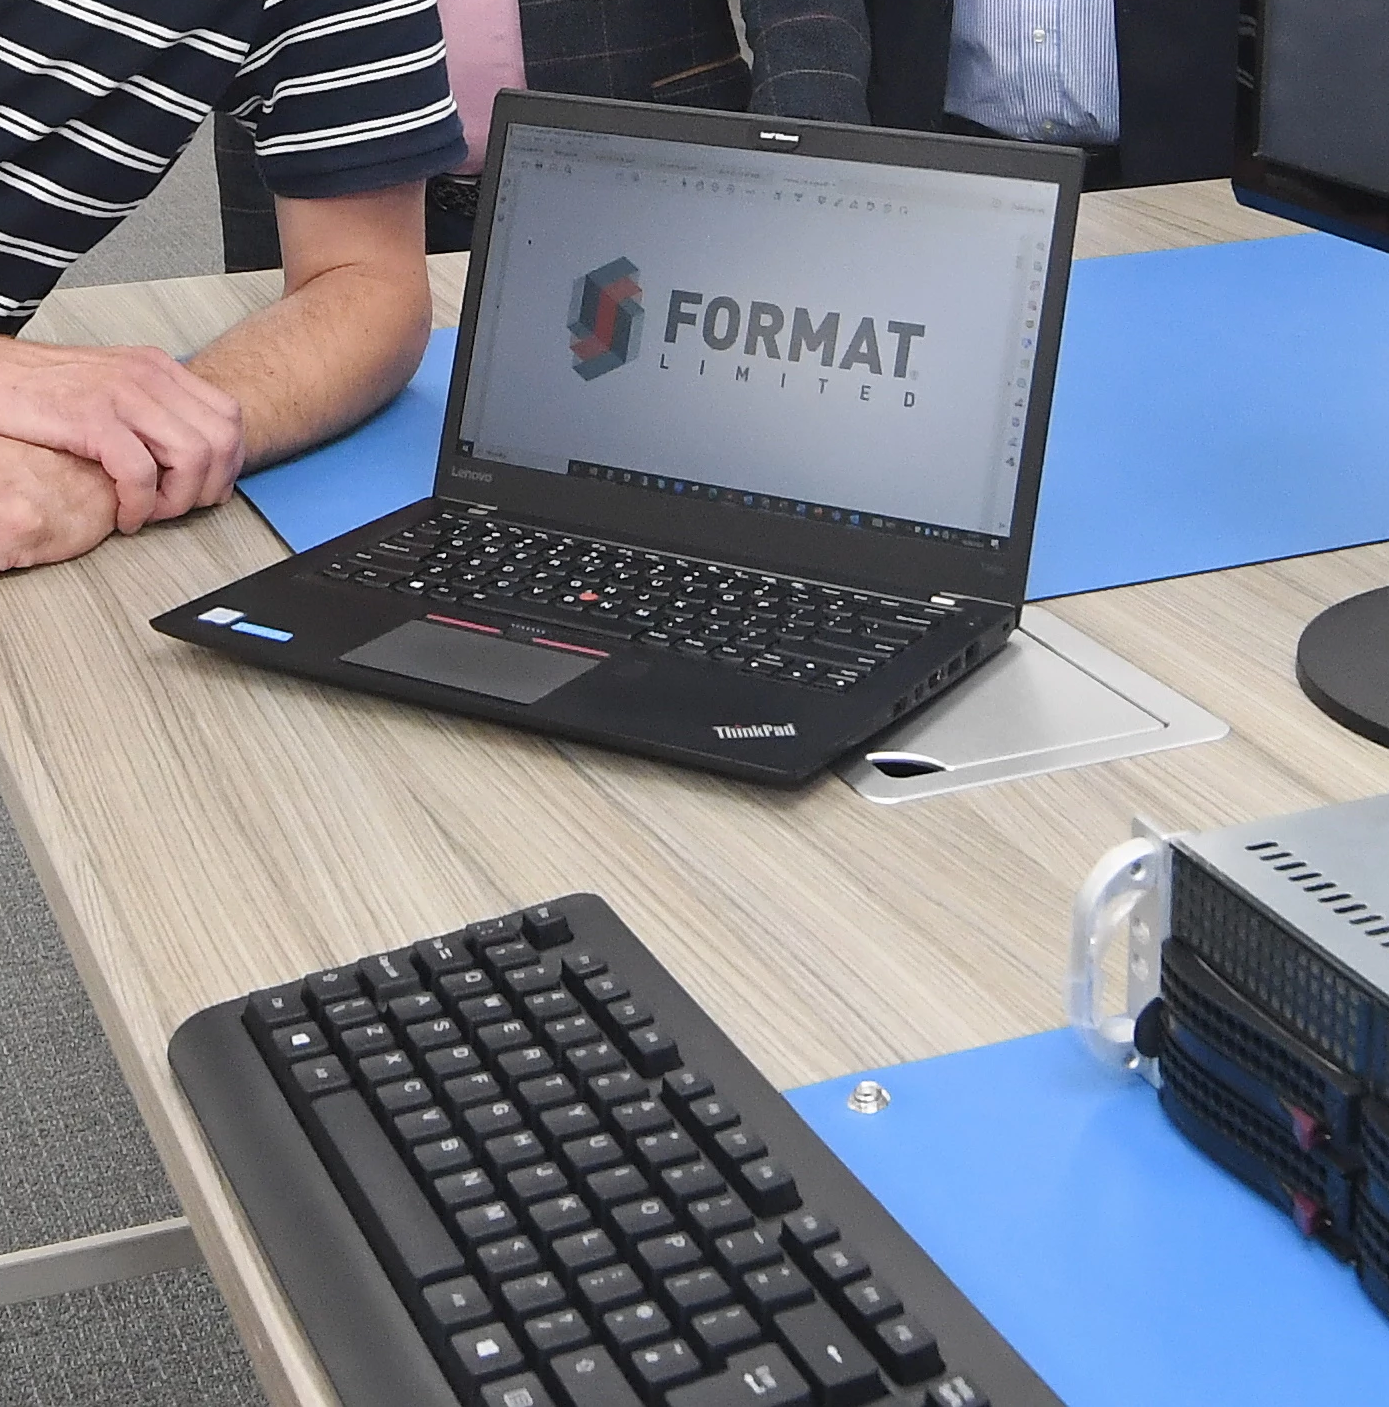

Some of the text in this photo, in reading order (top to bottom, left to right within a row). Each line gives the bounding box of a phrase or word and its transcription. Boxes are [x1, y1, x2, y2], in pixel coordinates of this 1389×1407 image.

[663, 290, 926, 378] FORMAT
[660, 353, 916, 407] LIMITED
[451, 465, 494, 483] Lenovo
[712, 722, 797, 739] ThinkPad
